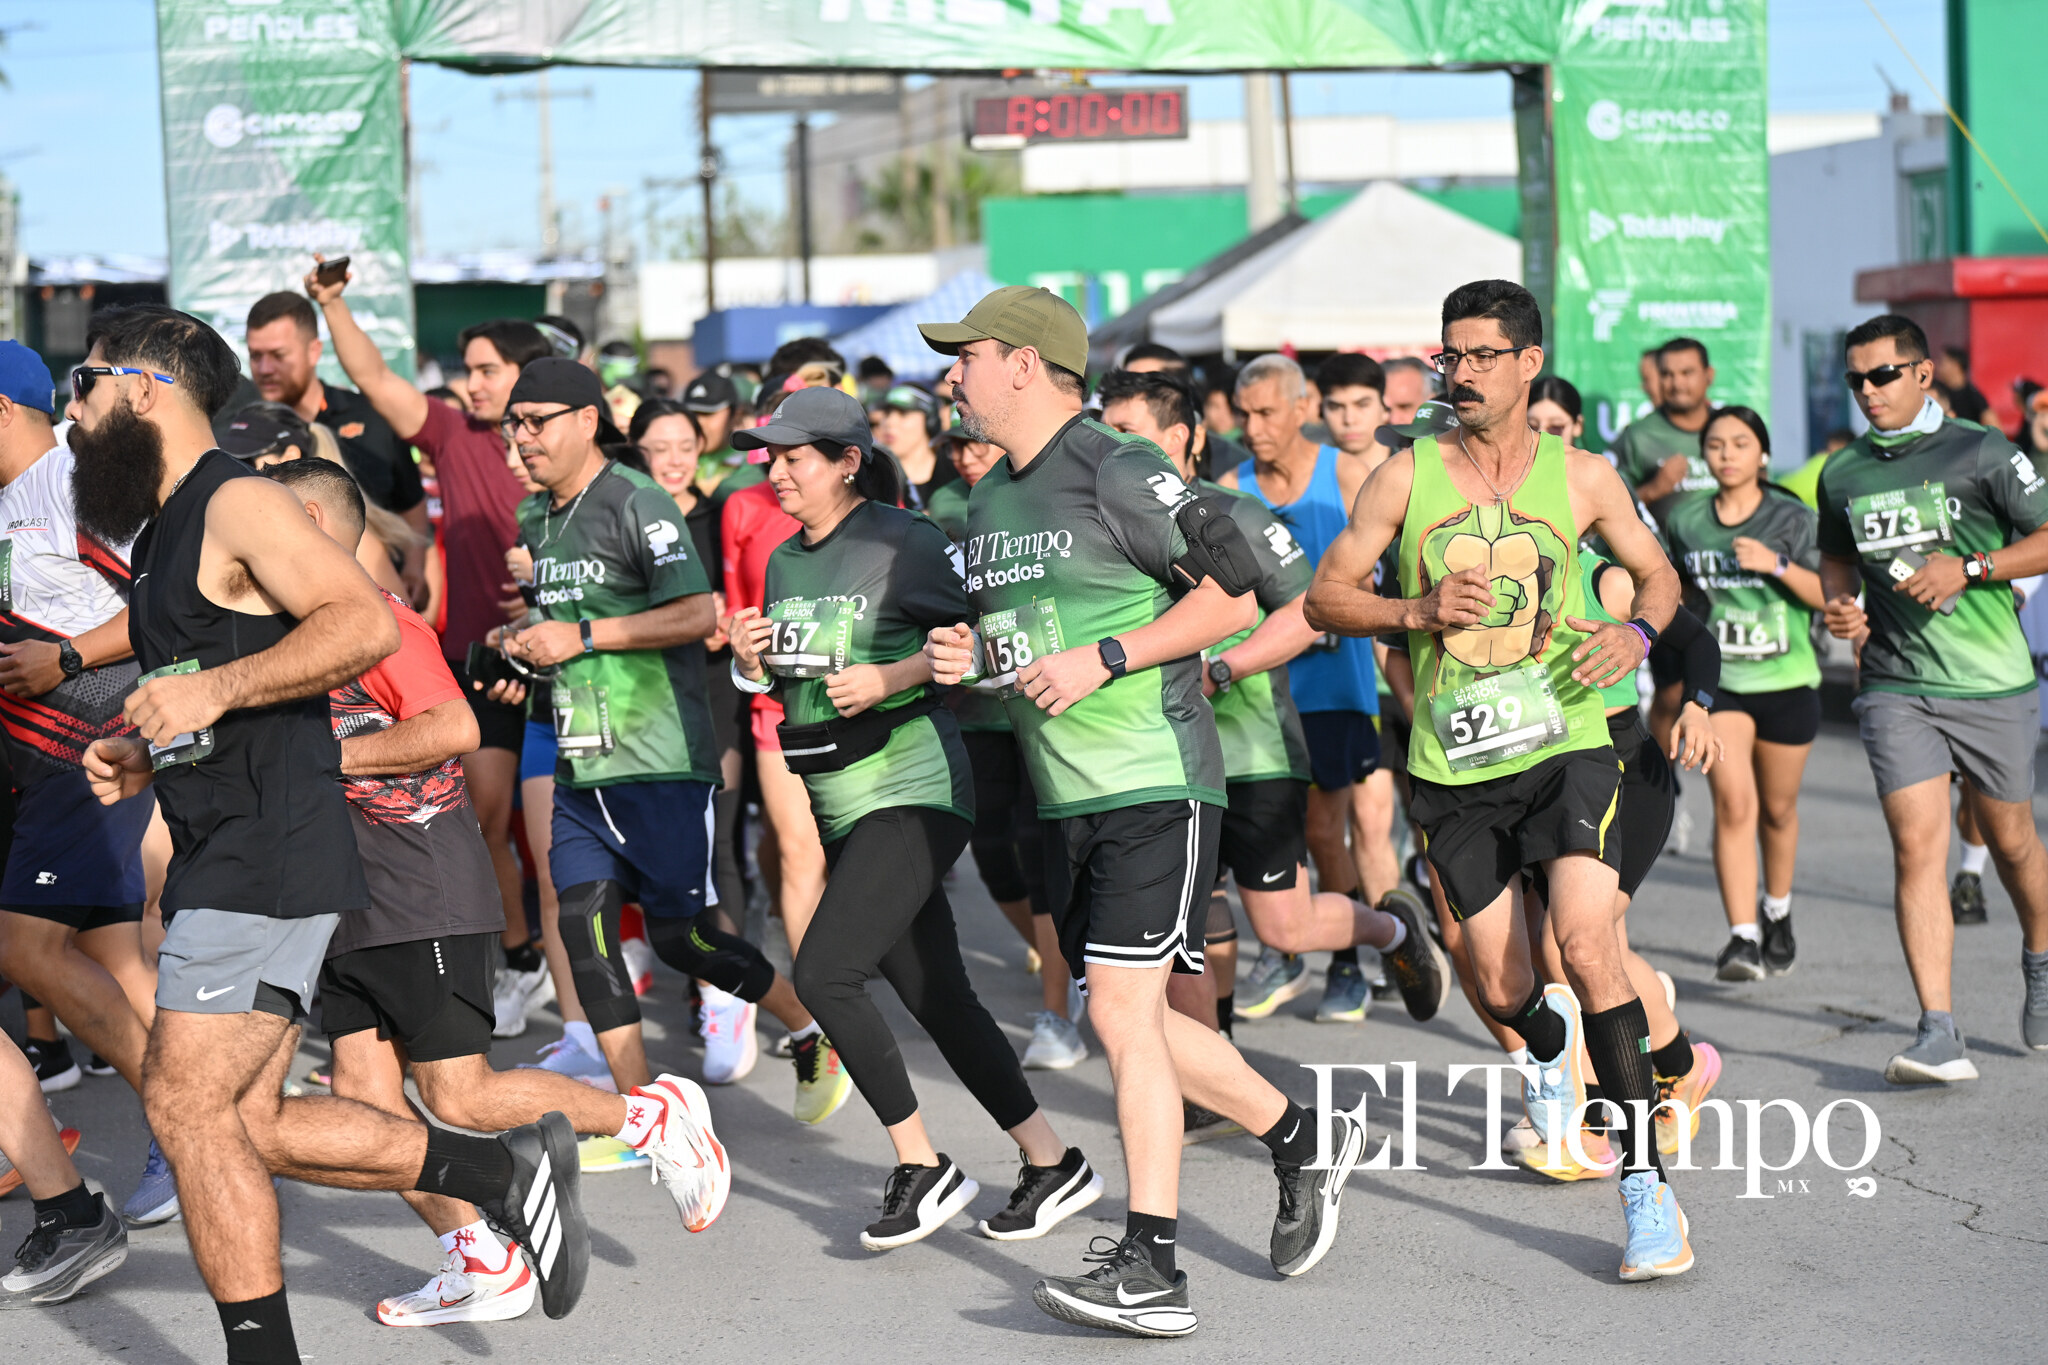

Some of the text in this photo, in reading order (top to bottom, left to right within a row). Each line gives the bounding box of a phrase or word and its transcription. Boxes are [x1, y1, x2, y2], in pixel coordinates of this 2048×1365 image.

[1624, 108, 1731, 132] cimaco
[1863, 505, 1922, 541] 573
[968, 529, 1073, 569] El Tiempo
[539, 557, 606, 586] Tiempo
[984, 563, 1045, 588] todos
[839, 607, 852, 615] 157
[984, 611, 1017, 626] CARRERA
[1040, 605, 1054, 615] 158
[771, 621, 820, 653] 157
[834, 620, 848, 671] MEDALLA
[1716, 620, 1768, 646] 116
[986, 631, 1033, 674] 158
[1453, 678, 1499, 697] CARRERA
[1450, 696, 1522, 744] 529
